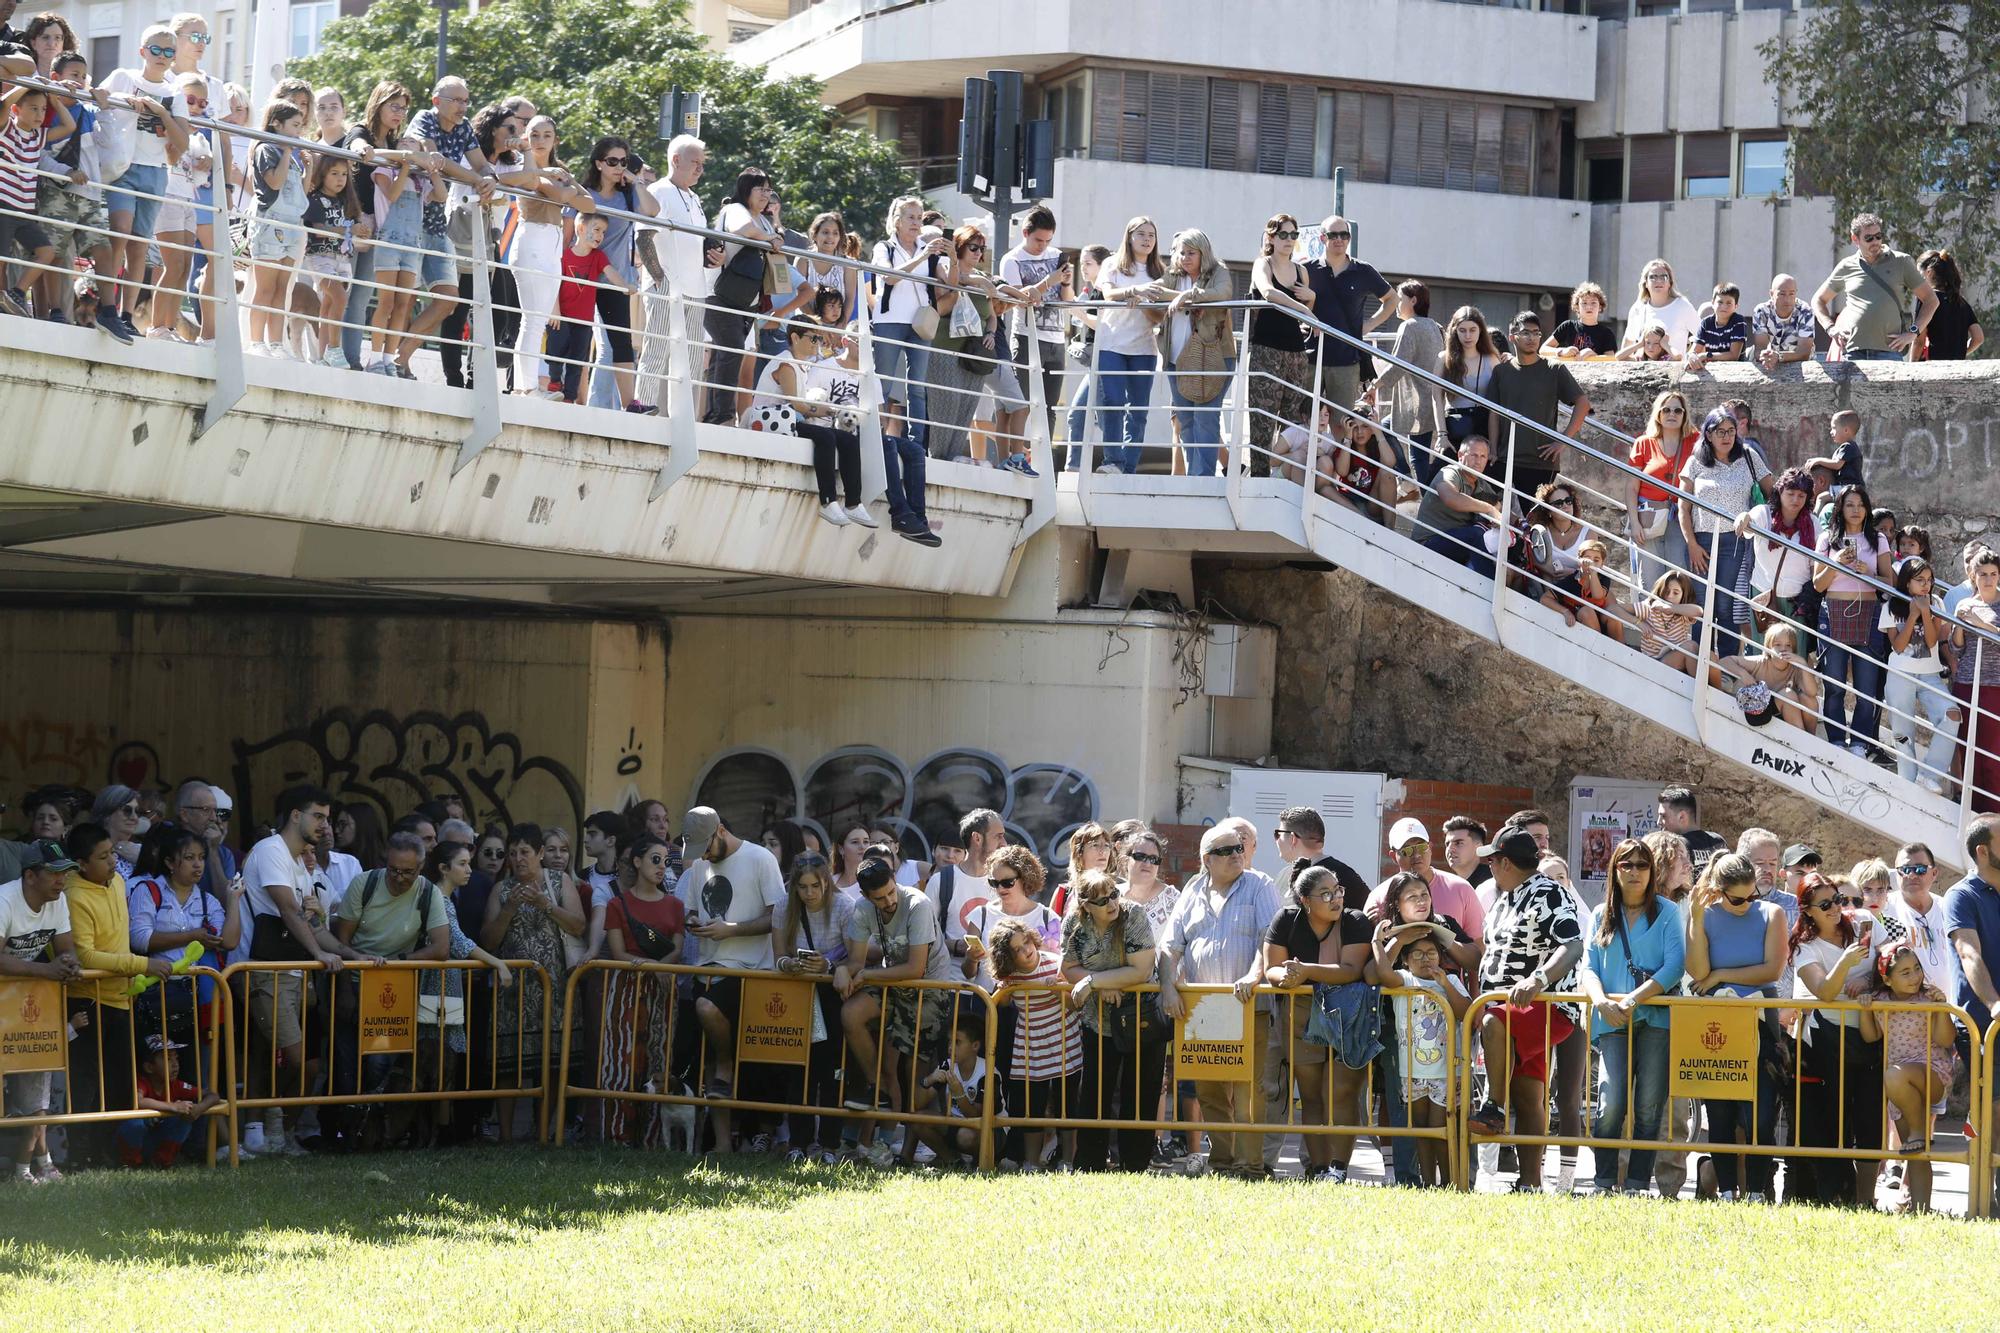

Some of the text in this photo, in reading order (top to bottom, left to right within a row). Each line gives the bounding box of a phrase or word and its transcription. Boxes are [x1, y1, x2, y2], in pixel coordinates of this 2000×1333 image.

[1751, 748, 1806, 778] CRUDX
[364, 1016, 409, 1025] AJUNTAMENT
[3, 1031, 58, 1041] AJUNTAMENT
[364, 1025, 409, 1037] DE VALÈNCIA
[746, 1025, 804, 1036] AJUNTAMENT
[745, 1035, 757, 1045] DE
[3, 1045, 15, 1054] DE
[1181, 1043, 1245, 1053] AJUNTAMENT
[1181, 1054, 1244, 1065] DE VALÈNCIA
[1679, 1058, 1749, 1069] AJUNTAMENT
[1679, 1069, 1749, 1082] DE VALÈNCIA
